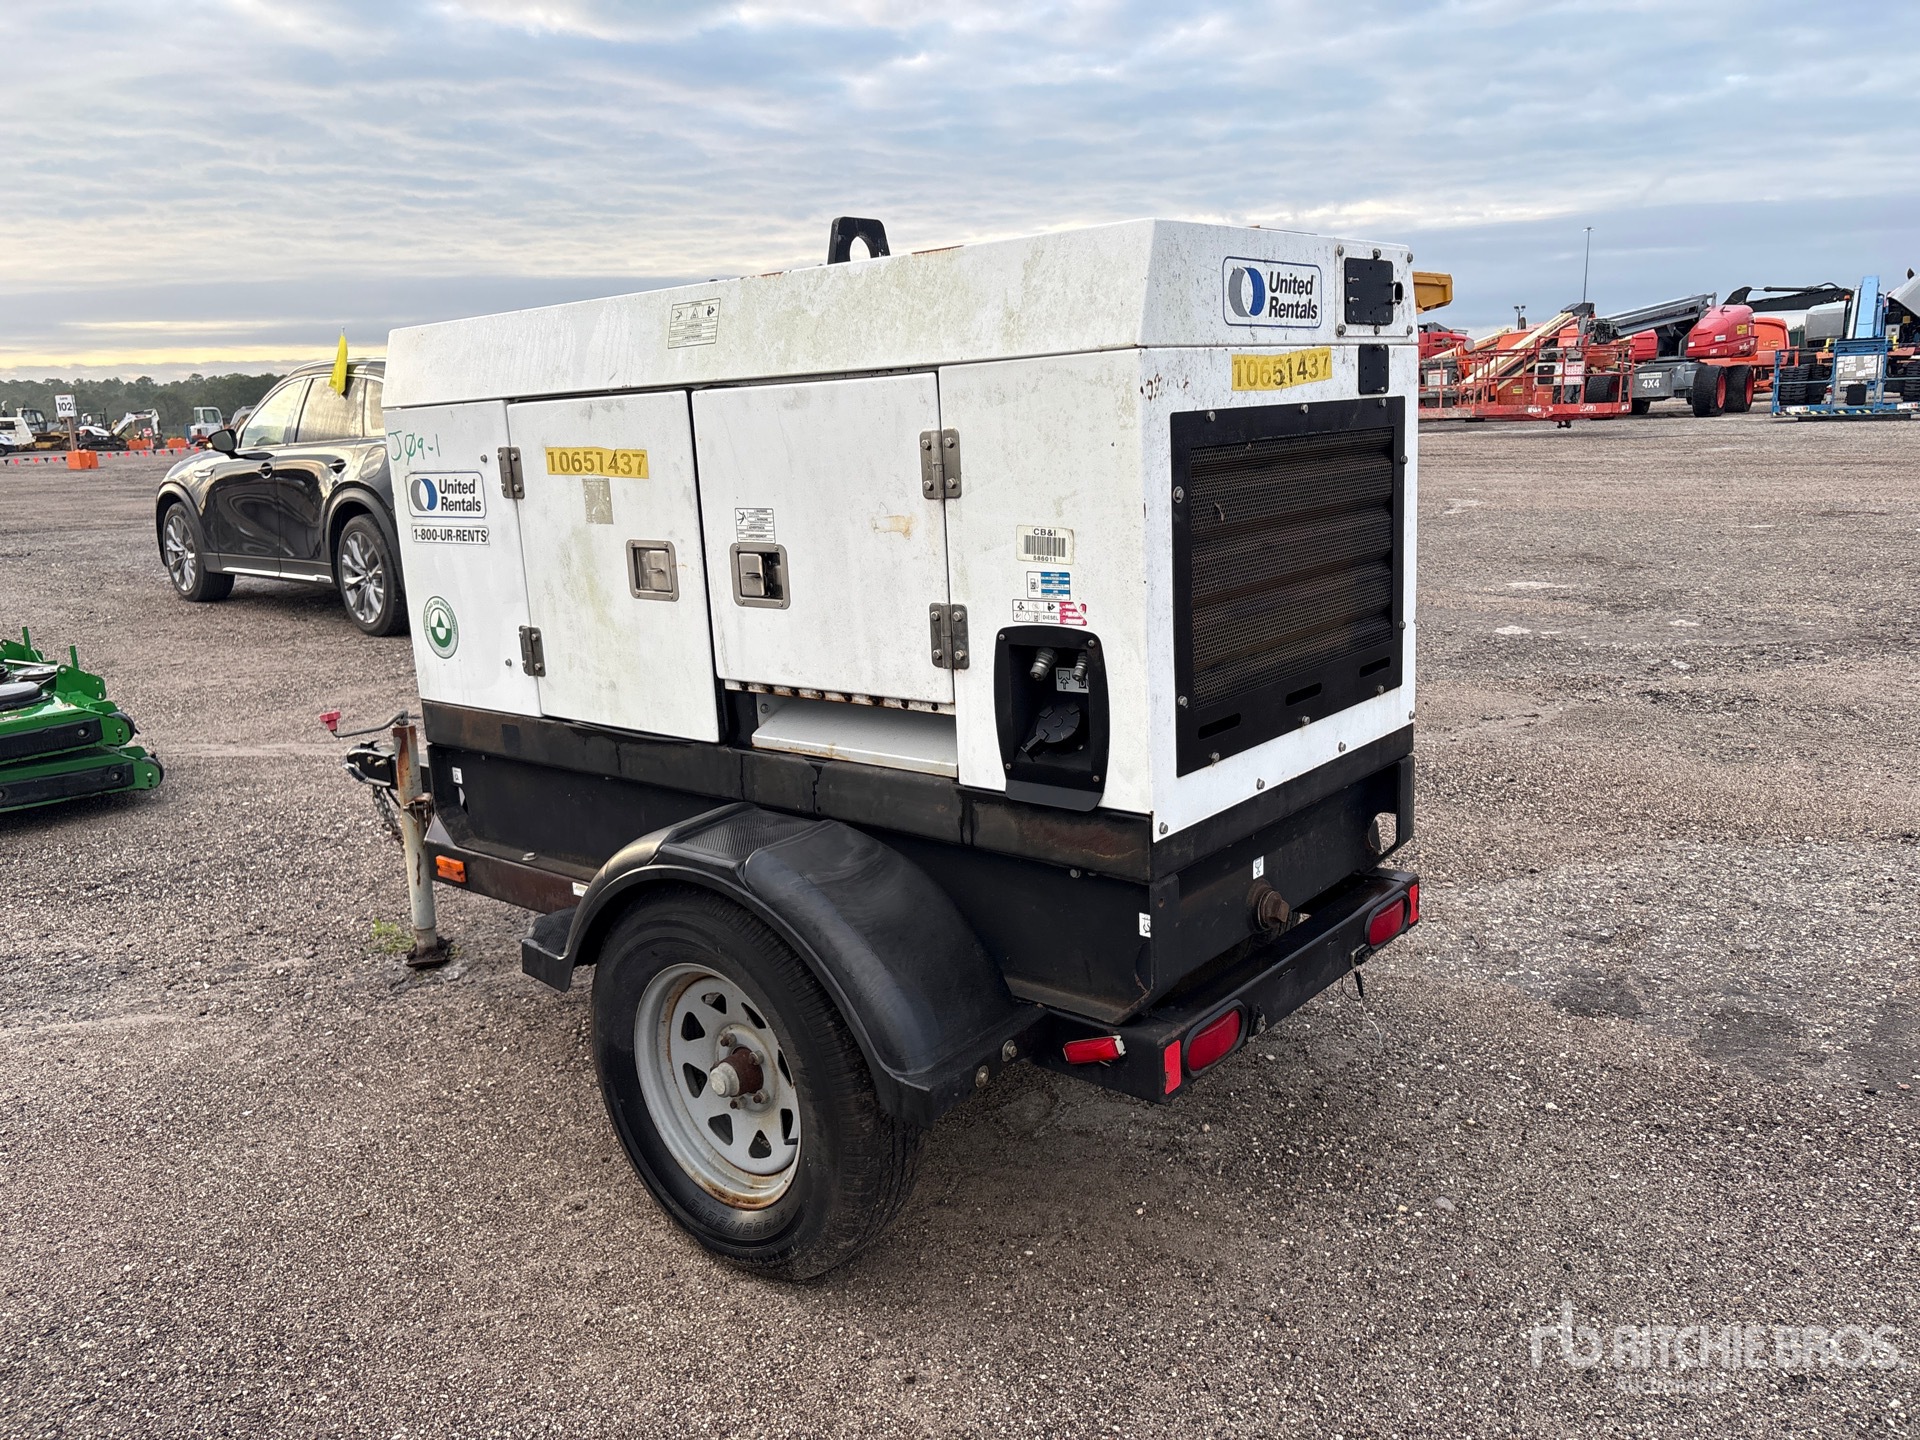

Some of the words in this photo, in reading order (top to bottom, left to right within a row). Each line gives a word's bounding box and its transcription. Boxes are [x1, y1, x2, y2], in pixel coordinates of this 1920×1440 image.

[1268, 271, 1314, 295] United
[1268, 297, 1318, 320] Rentals
[1233, 352, 1330, 387] 10651437
[57, 402, 73, 411] 102
[547, 451, 645, 476] 10651437
[439, 479, 476, 494] United
[441, 496, 482, 512] Rentals
[414, 528, 487, 542] 1-800-UR-RENTS
[1033, 528, 1057, 537] CB&I
